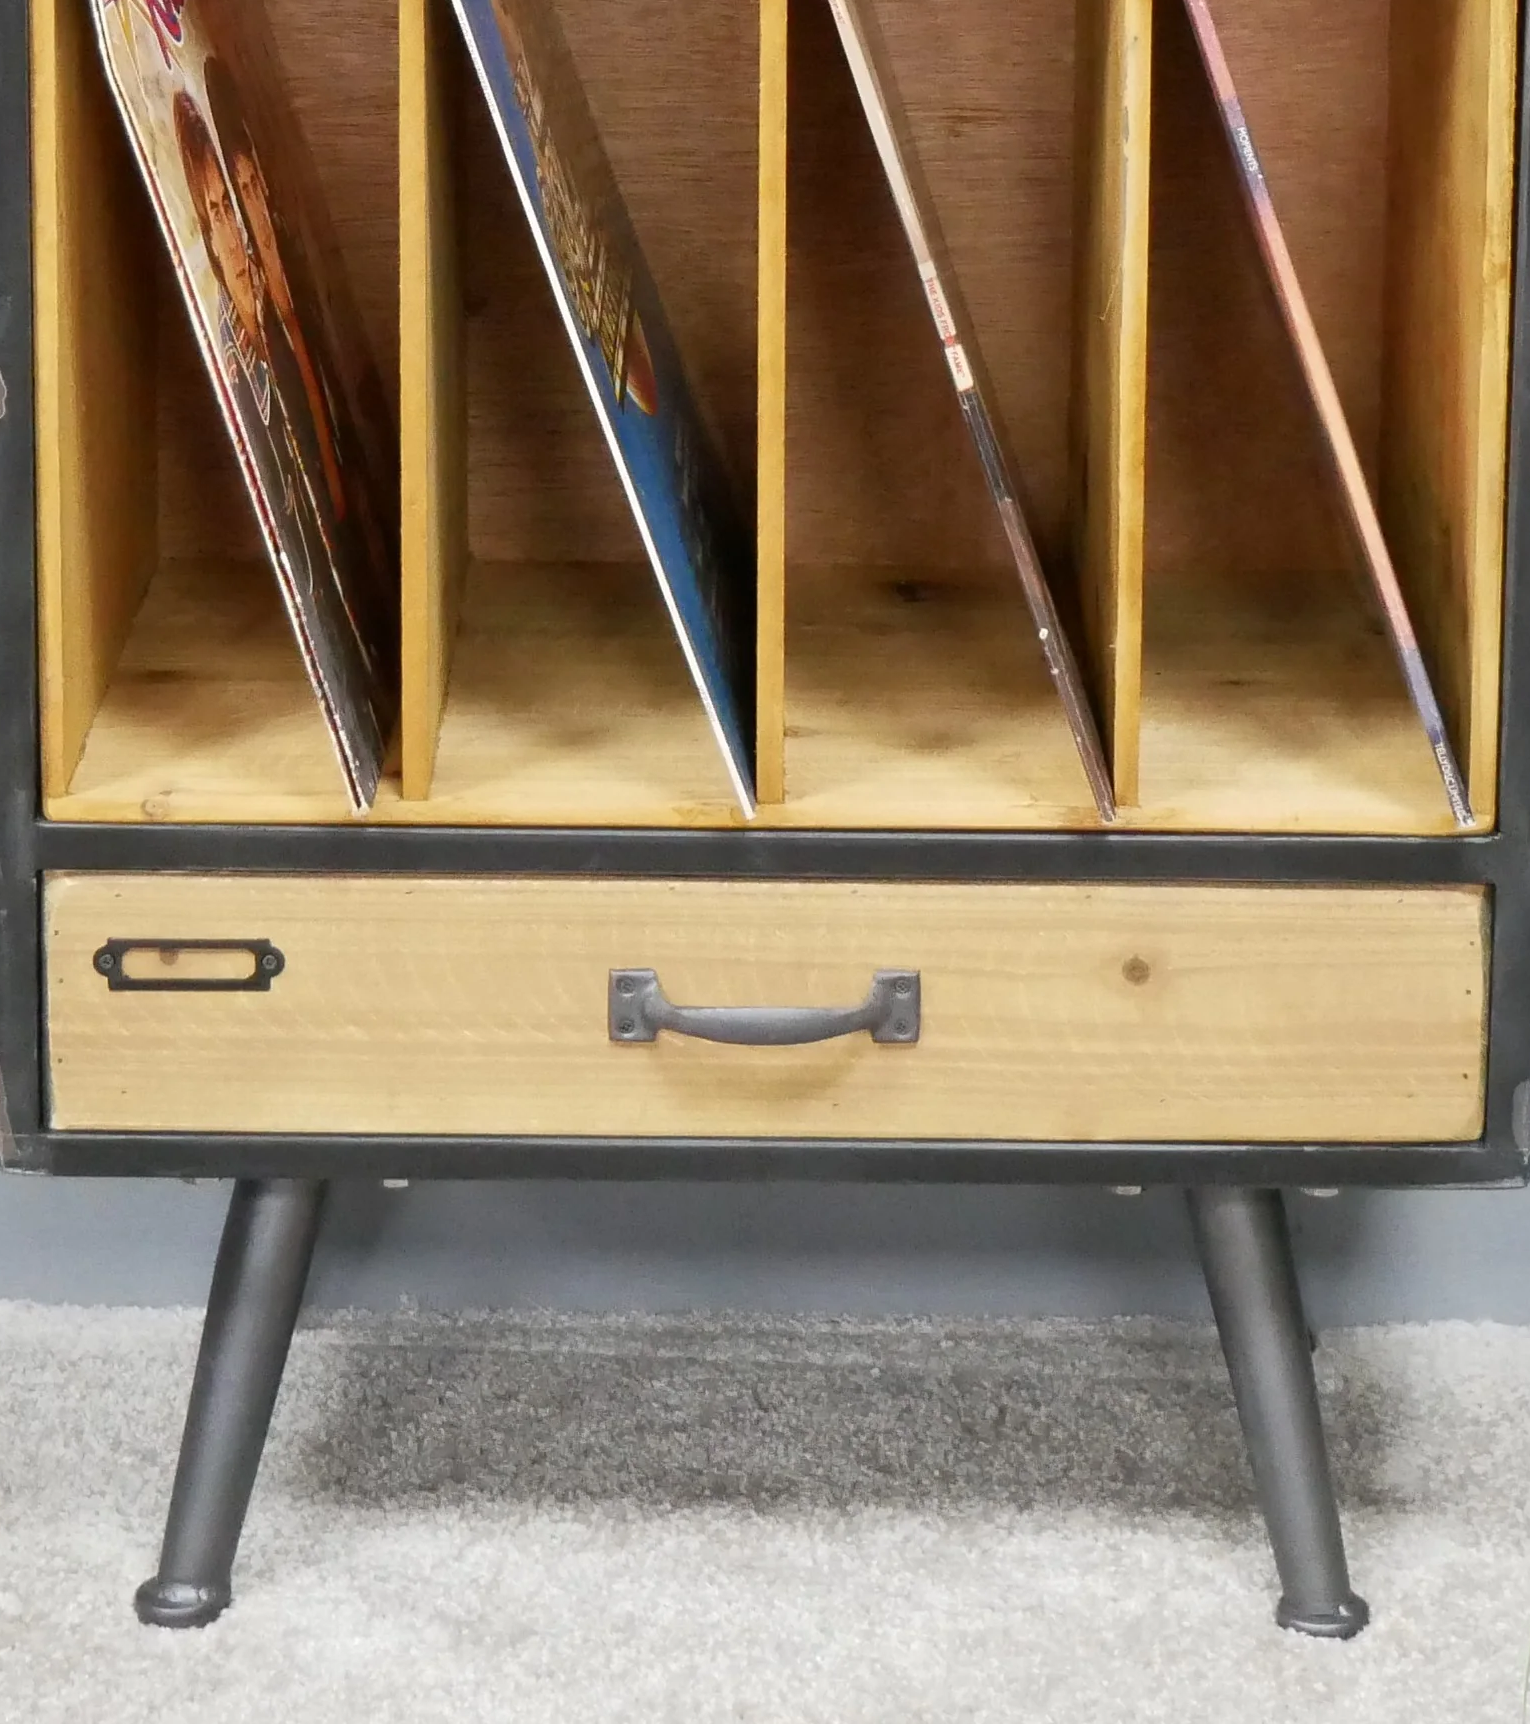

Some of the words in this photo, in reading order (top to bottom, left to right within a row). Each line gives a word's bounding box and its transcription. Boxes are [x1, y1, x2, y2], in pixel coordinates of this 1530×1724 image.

[1236, 125, 1258, 171] MOMENTS
[925, 277, 936, 294] THE
[932, 297, 944, 317] KIDS
